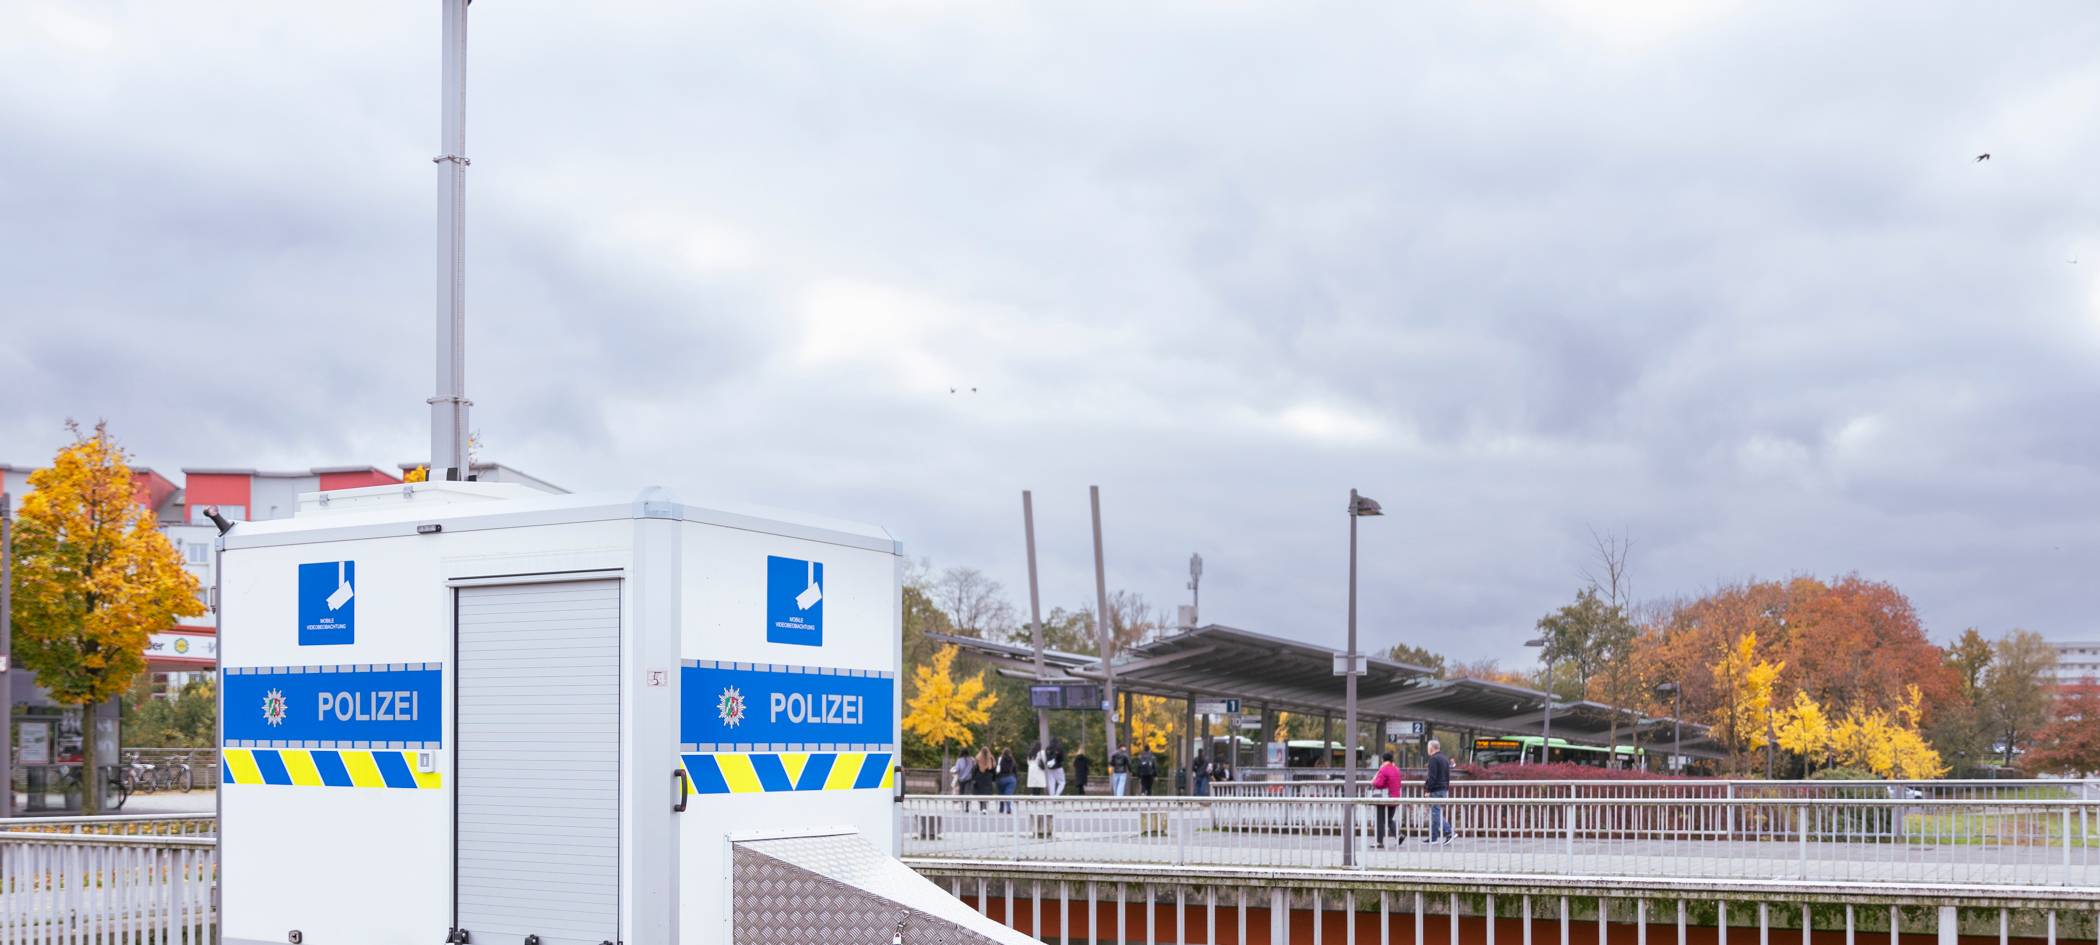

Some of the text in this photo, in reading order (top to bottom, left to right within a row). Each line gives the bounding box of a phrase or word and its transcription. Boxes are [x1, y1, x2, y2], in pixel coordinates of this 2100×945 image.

[318, 691, 418, 721] POLIZEI
[770, 692, 863, 724] POLIZEI
[1414, 723, 1421, 733] 2
